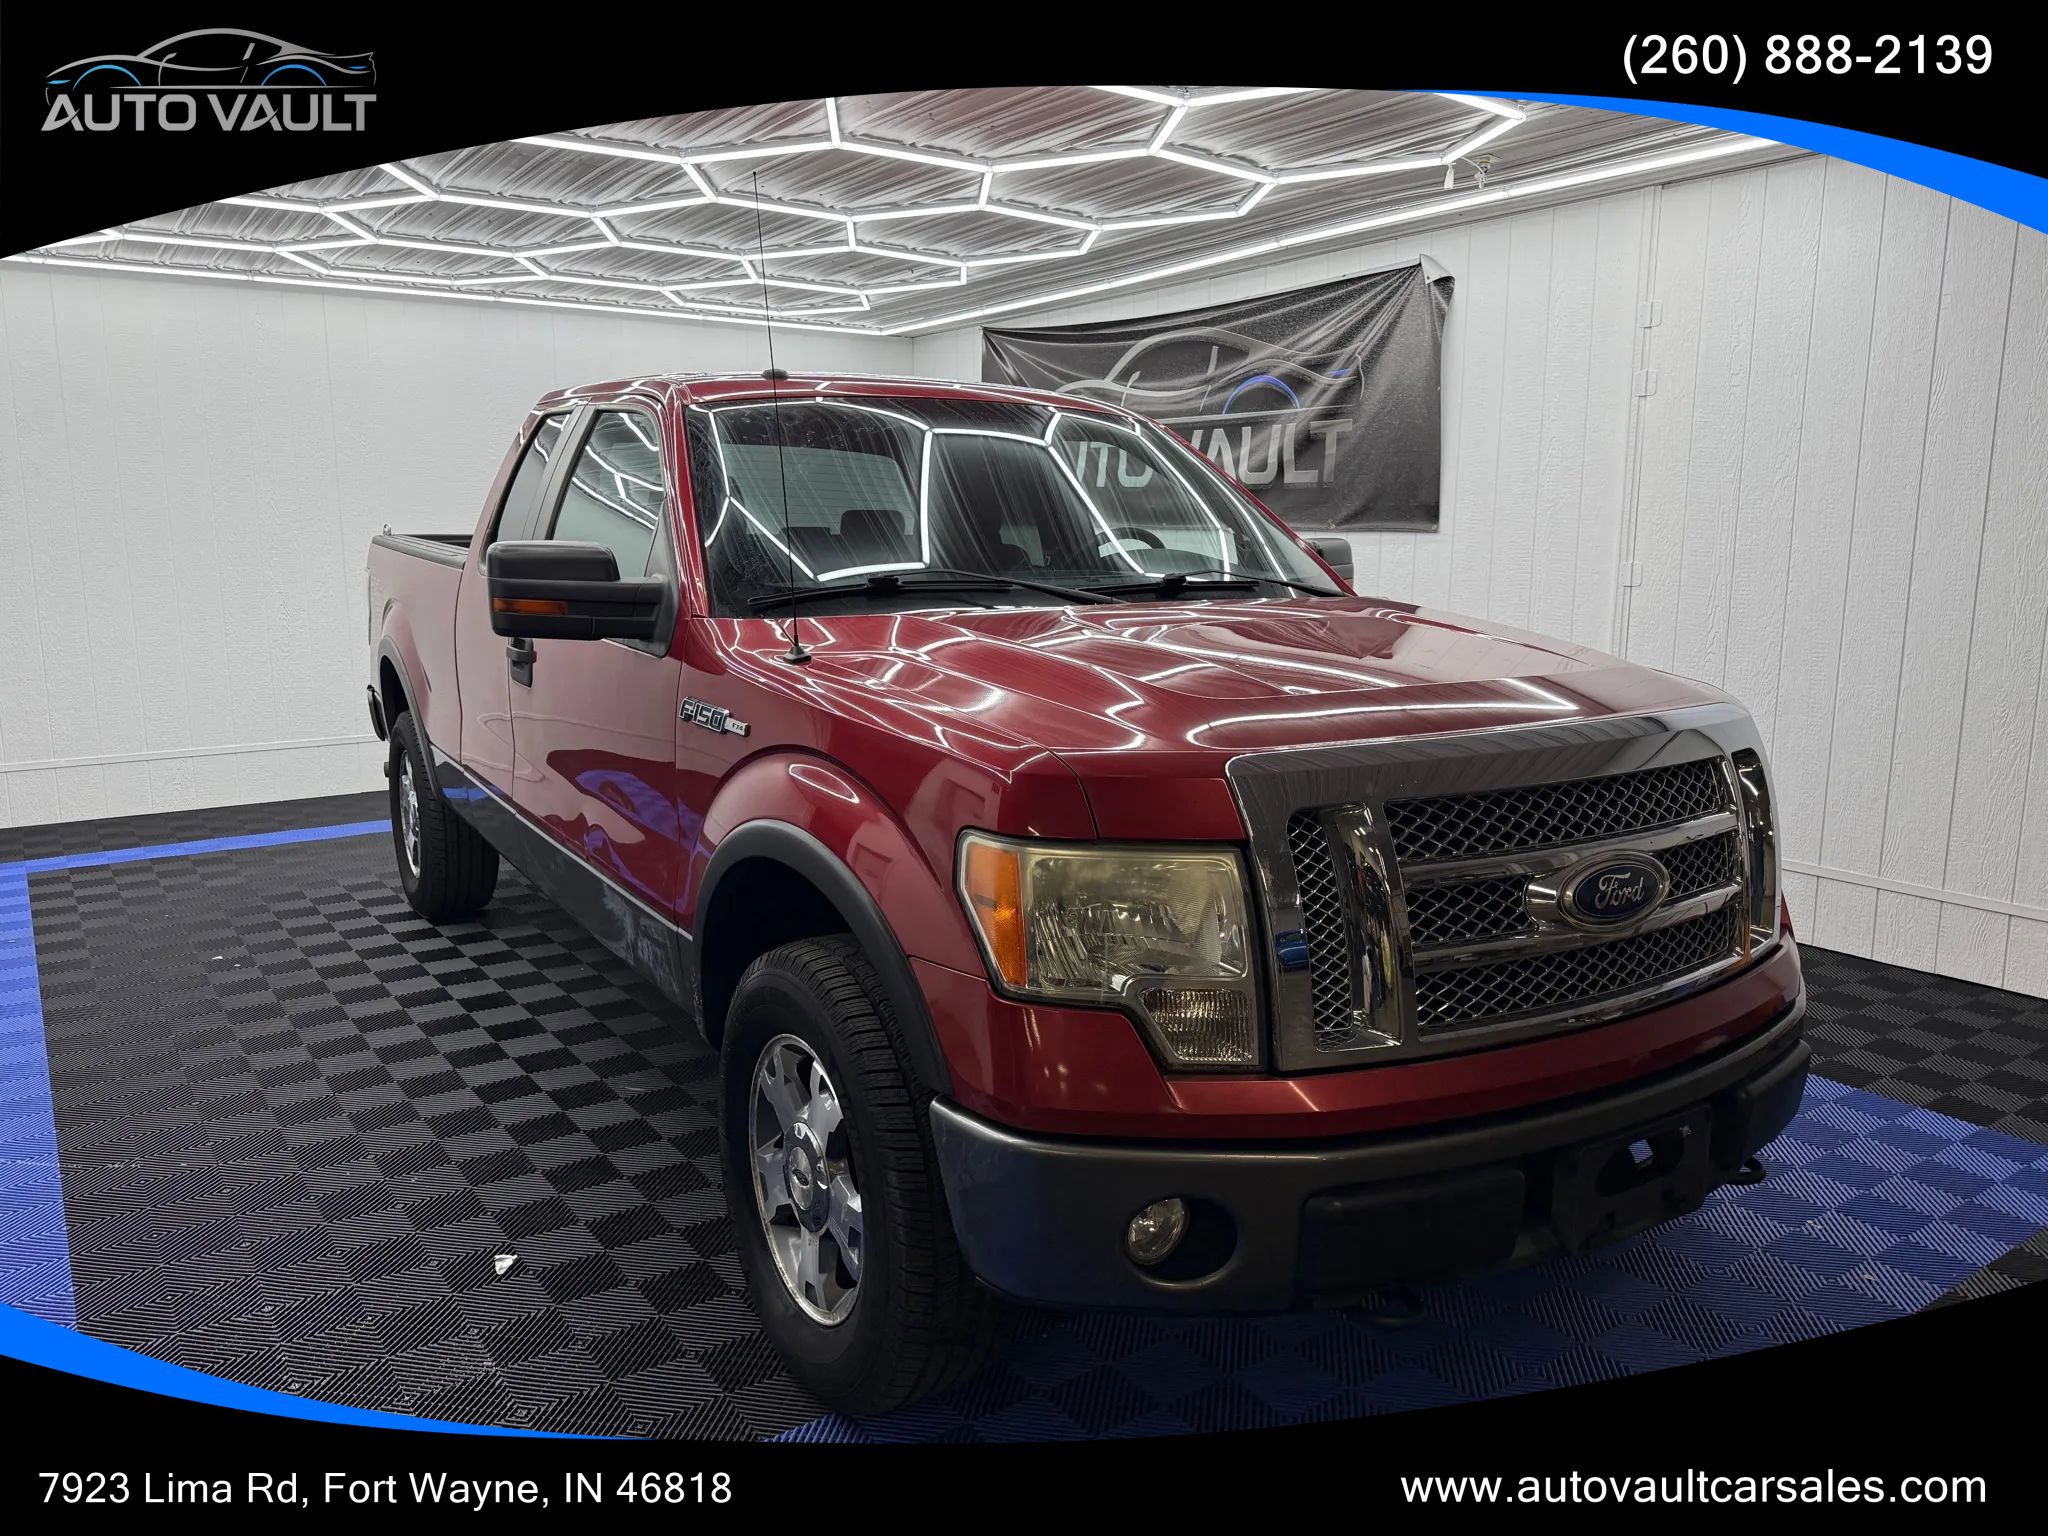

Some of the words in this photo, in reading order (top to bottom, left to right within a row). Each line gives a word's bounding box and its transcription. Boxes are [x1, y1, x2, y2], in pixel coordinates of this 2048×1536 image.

[1191, 419, 1353, 485] AULT
[678, 697, 726, 733] F-150
[1594, 871, 1645, 910] Ford
